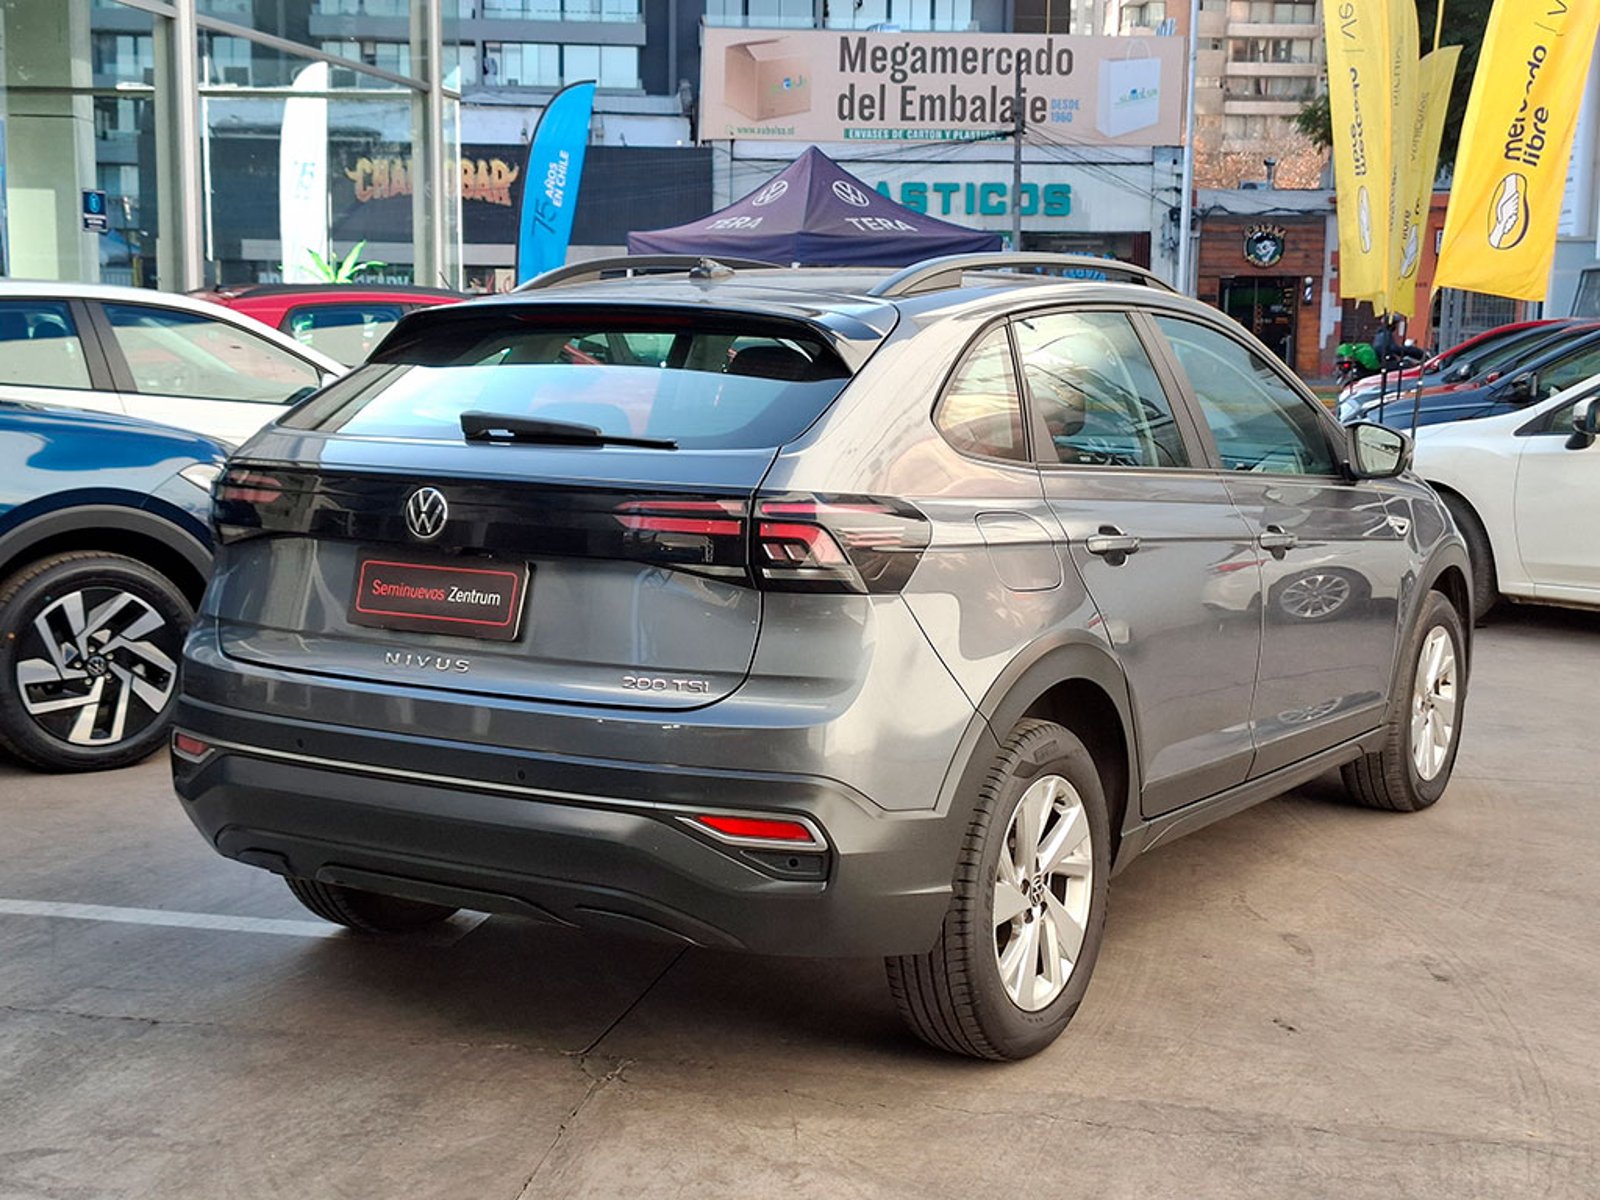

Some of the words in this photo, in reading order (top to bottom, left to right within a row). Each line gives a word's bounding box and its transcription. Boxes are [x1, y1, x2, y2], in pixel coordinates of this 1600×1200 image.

[838, 36, 1074, 83] Megamercado
[837, 83, 887, 122] del
[849, 128, 890, 140] ENVASES
[1522, 106, 1549, 167] libre
[555, 149, 570, 187] CHILE
[552, 187, 564, 208] EN
[844, 216, 918, 232] TERA
[371, 579, 445, 601] Seminuevos
[447, 586, 501, 606] Zentrum
[384, 652, 470, 673] NIVUS
[621, 675, 667, 691] 200
[671, 679, 710, 693] TSI
